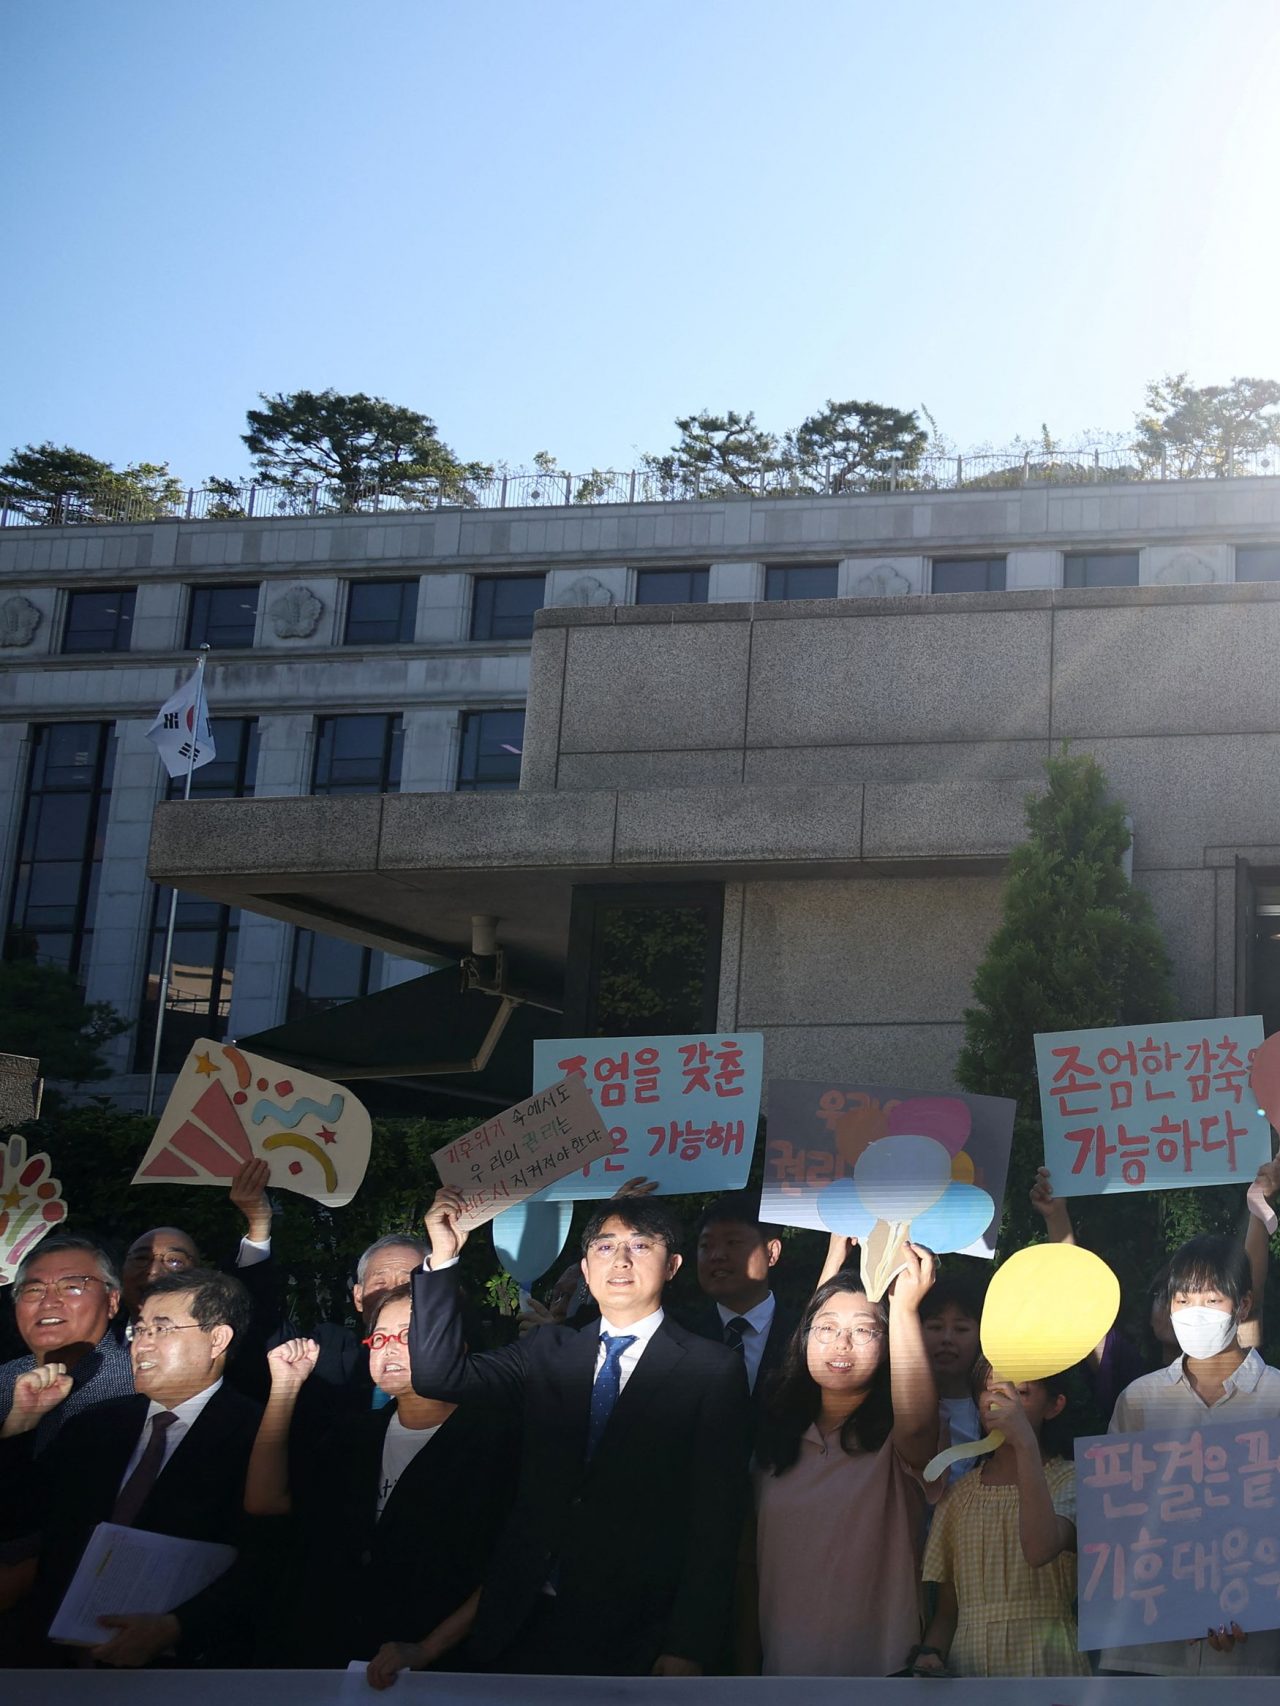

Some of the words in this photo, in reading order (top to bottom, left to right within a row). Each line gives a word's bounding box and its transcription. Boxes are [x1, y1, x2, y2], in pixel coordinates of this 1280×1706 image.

[677, 1040, 745, 1097] 갖춘
[443, 1118, 506, 1164] 기후위기
[511, 1083, 571, 1127] 속에서도
[471, 1143, 521, 1184] 우리의
[523, 1116, 573, 1153] 권리는
[646, 1119, 745, 1162] 가능해
[1063, 1109, 1249, 1186] 가능하다
